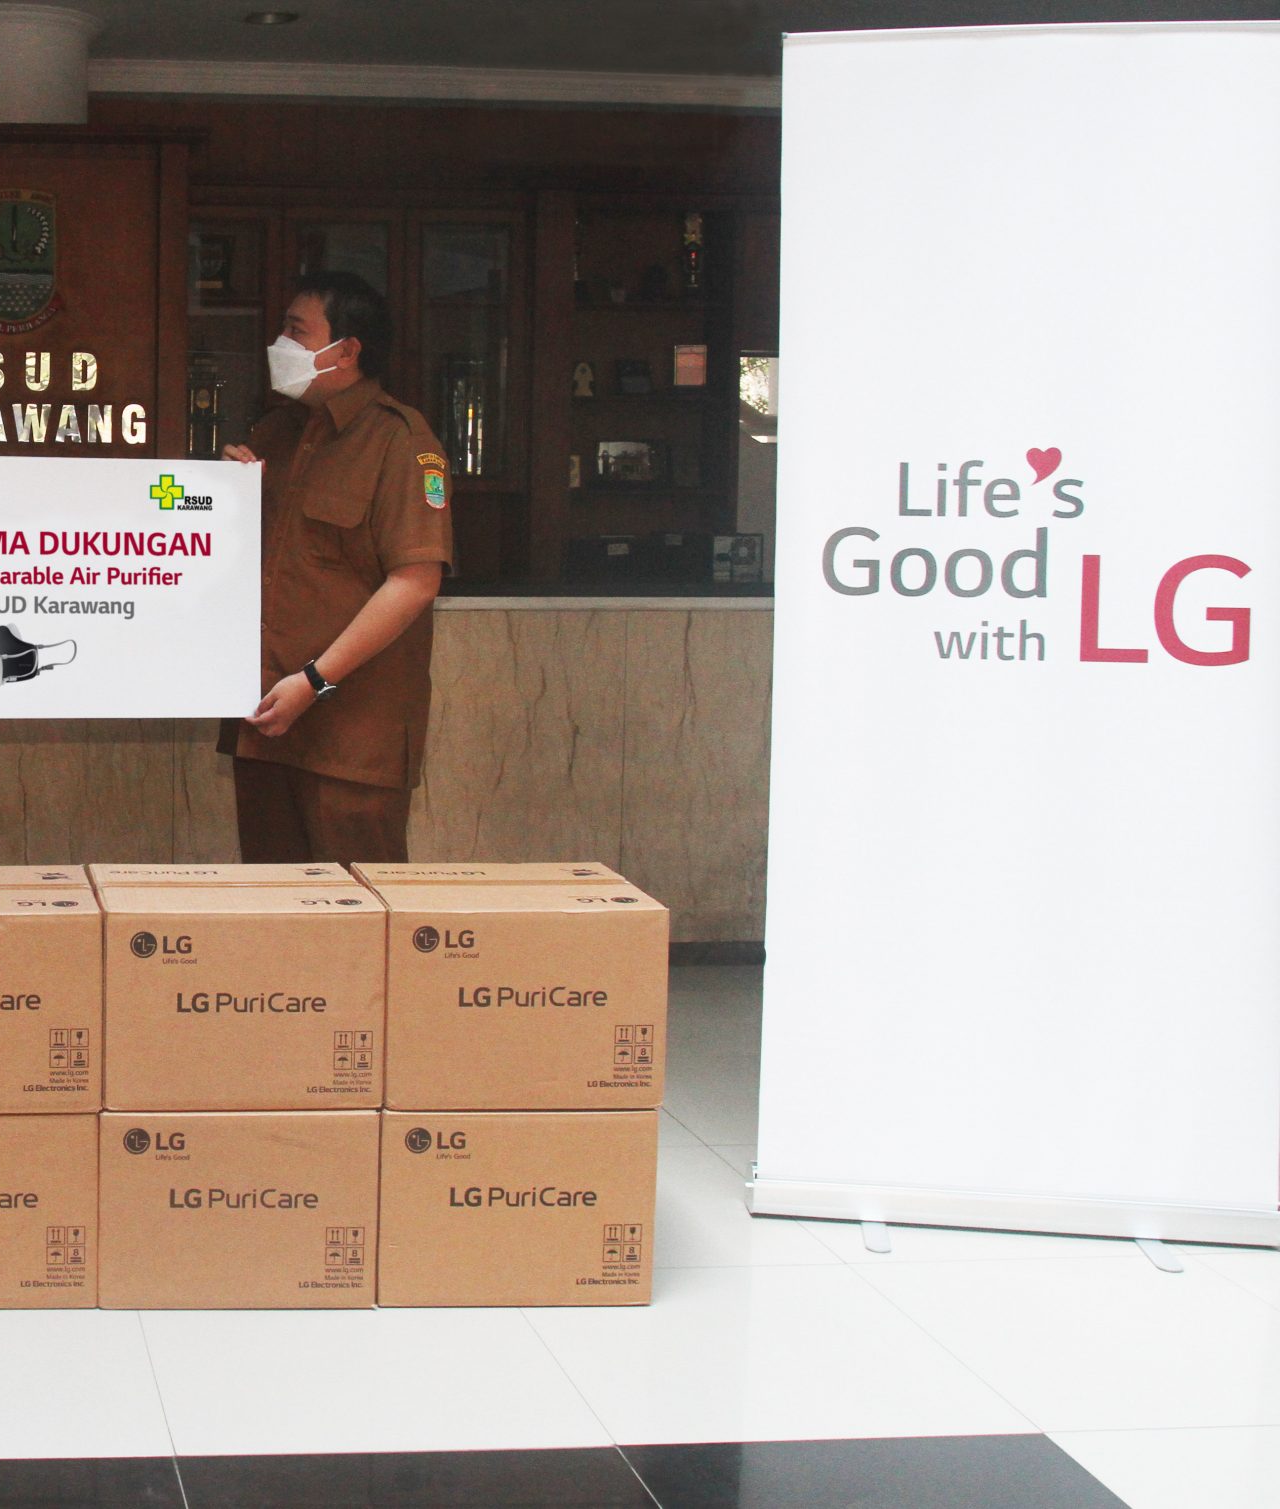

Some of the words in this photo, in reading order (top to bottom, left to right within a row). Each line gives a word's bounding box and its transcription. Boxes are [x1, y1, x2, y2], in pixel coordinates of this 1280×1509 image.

[898, 447, 1085, 518] Life's
[184, 495, 213, 504] RSUD
[40, 532, 211, 556] DUKUNGAN
[822, 526, 1048, 598] Good
[70, 567, 100, 585] Air
[108, 567, 182, 585] Purifier
[35, 596, 134, 619] Karawang
[934, 619, 1046, 661] with
[1079, 554, 1253, 666] LG
[163, 936, 192, 954] LG
[445, 930, 474, 948] LG
[177, 992, 209, 1013] LG
[215, 992, 327, 1013] PuriCare
[459, 987, 491, 1008] LG
[497, 986, 608, 1008] PuriCare
[156, 1133, 185, 1150] LG
[437, 1132, 466, 1149] LG
[170, 1188, 202, 1209] LG
[208, 1188, 319, 1210] PuriCare
[450, 1187, 482, 1207] LG
[488, 1187, 597, 1208] PuriCare
